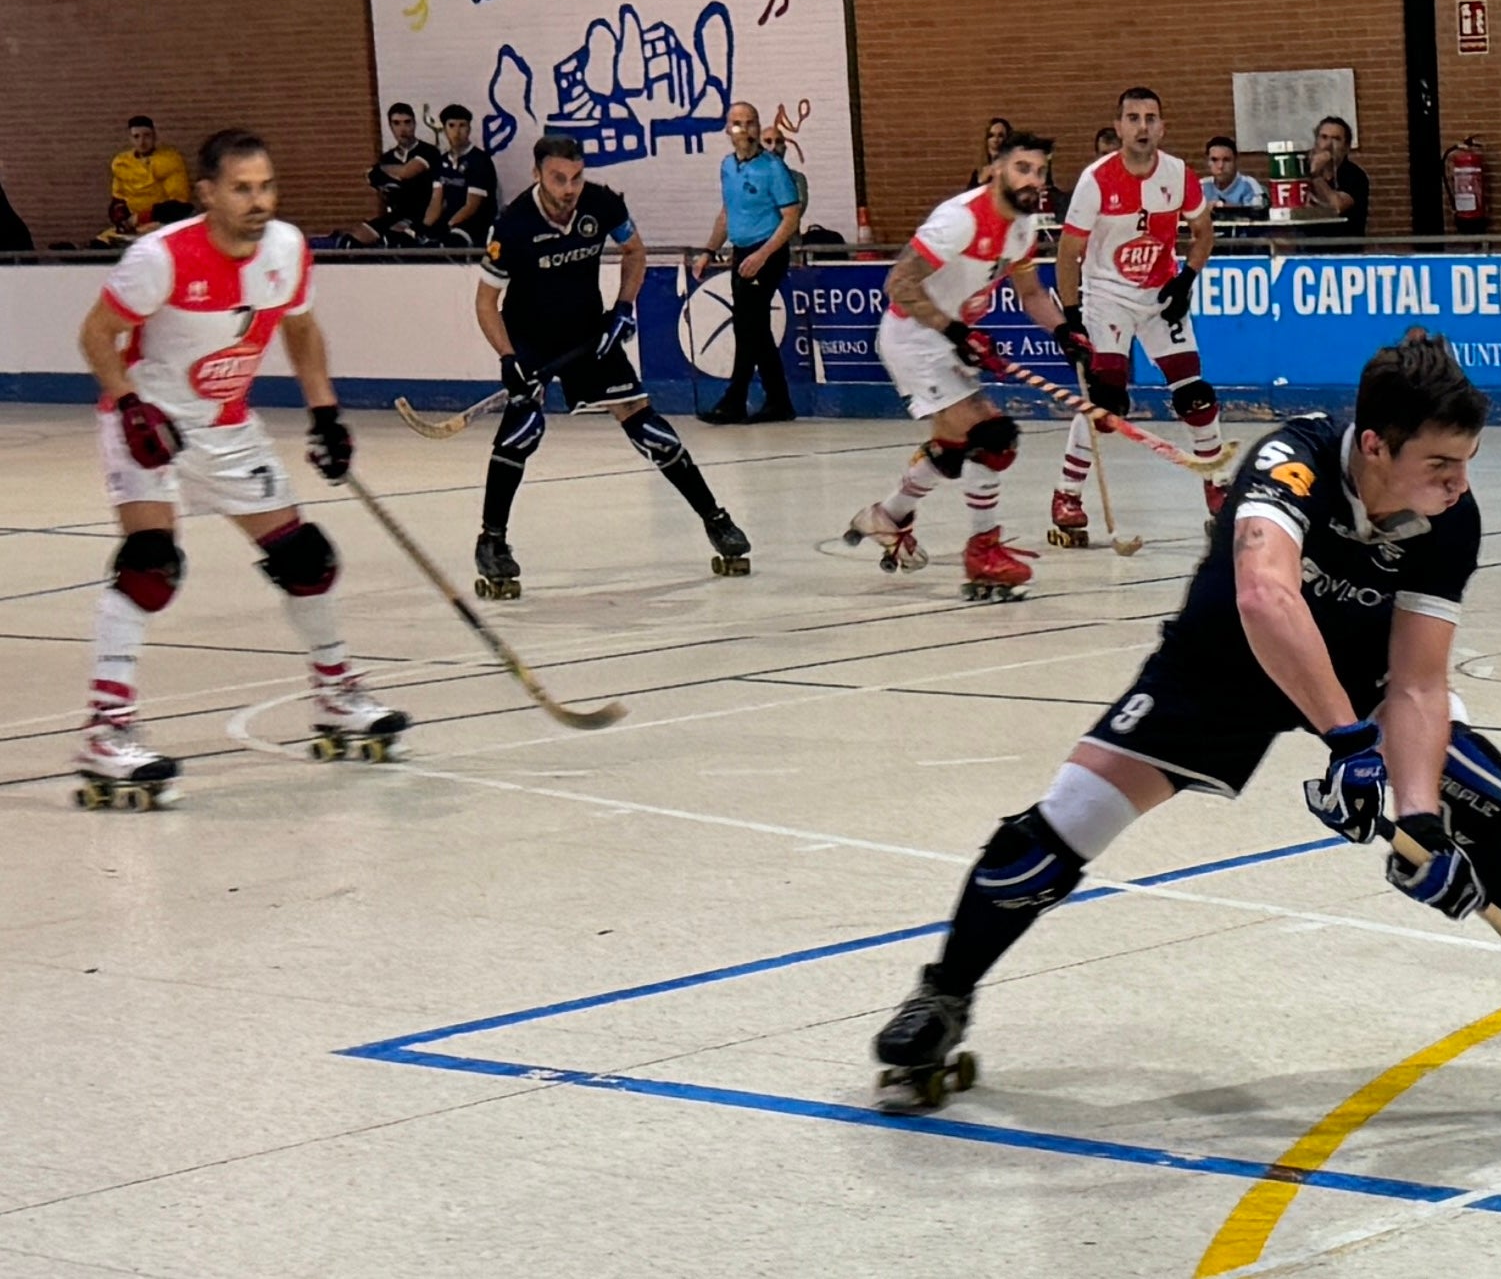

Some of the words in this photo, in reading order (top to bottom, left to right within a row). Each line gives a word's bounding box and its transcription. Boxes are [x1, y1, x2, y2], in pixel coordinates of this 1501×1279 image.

[1274, 154, 1290, 177] T
[1277, 183, 1291, 206] F
[792, 287, 883, 315] DEPOR
[1190, 266, 1281, 322] IEDO,
[1292, 265, 1440, 315] CAPITAL
